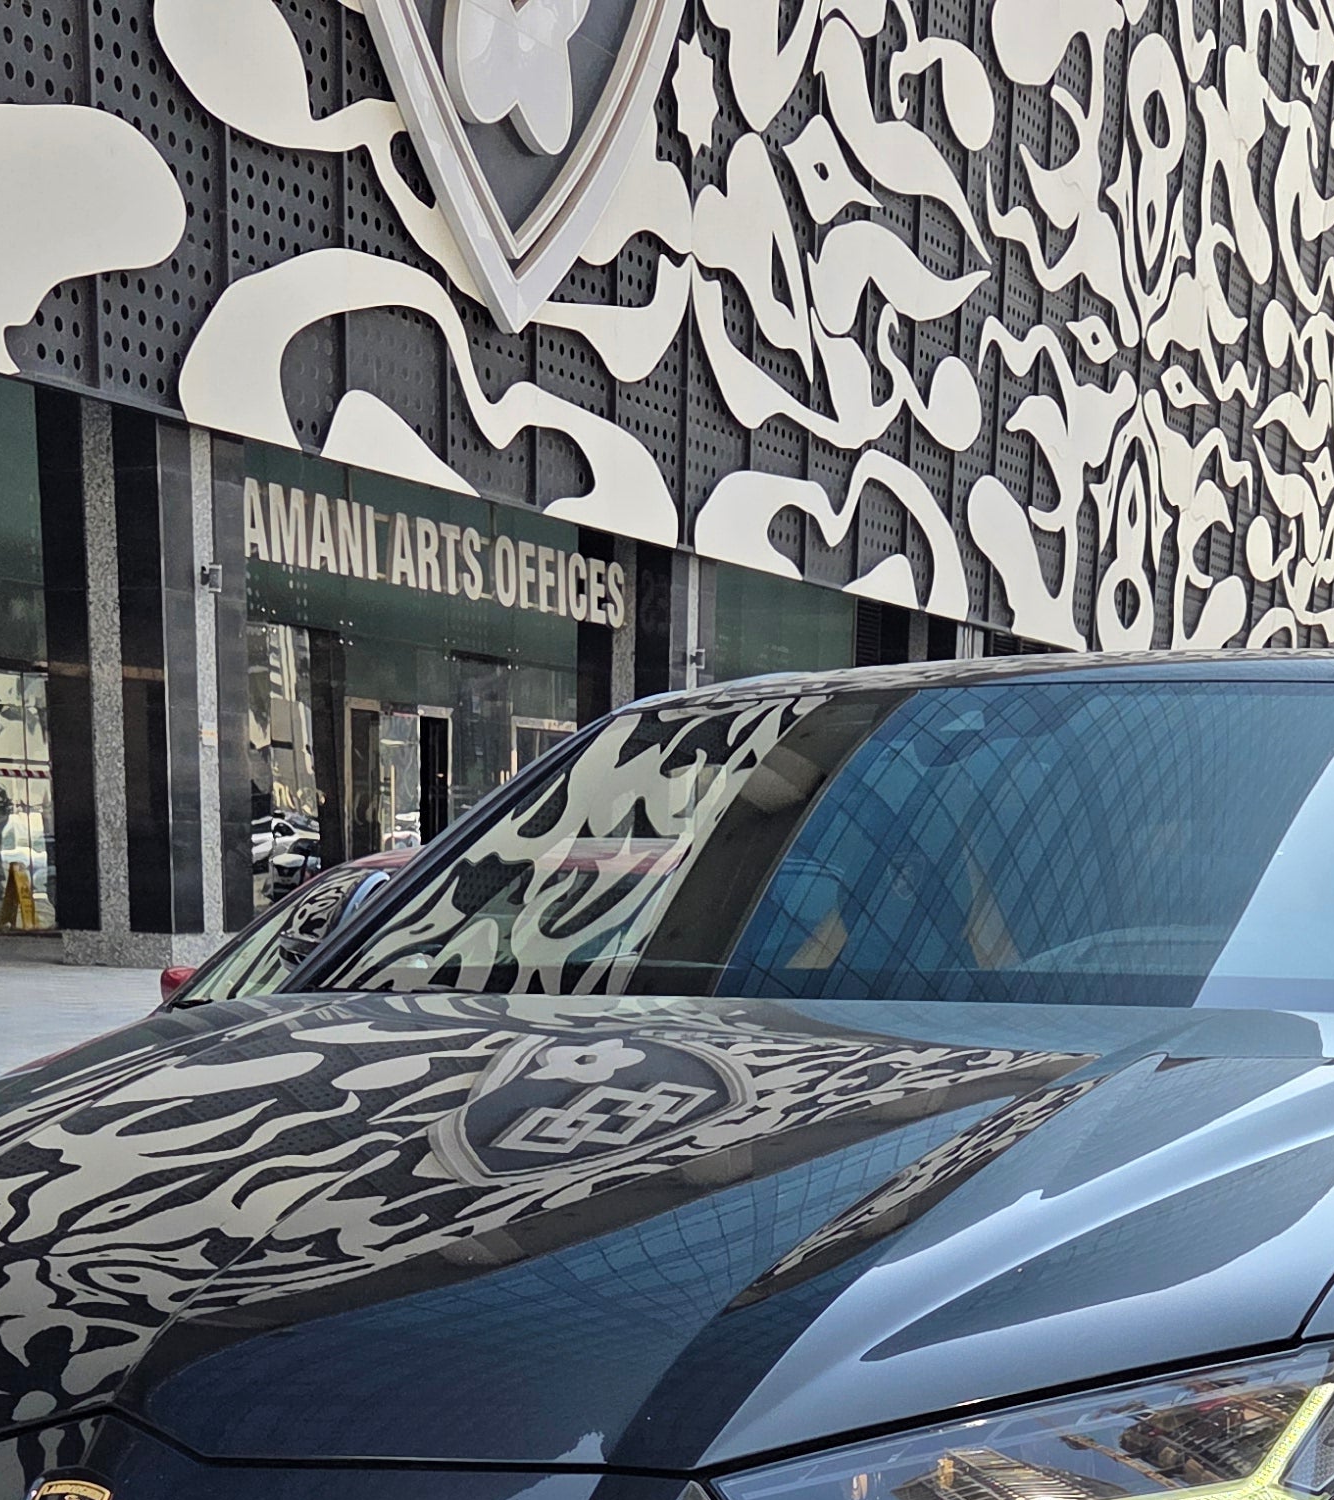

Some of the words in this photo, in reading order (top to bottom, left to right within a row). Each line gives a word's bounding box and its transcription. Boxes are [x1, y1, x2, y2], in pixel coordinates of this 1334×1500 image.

[243, 477, 378, 580] AMANI
[391, 512, 483, 600] ARTS
[494, 534, 625, 629] OFFICES
